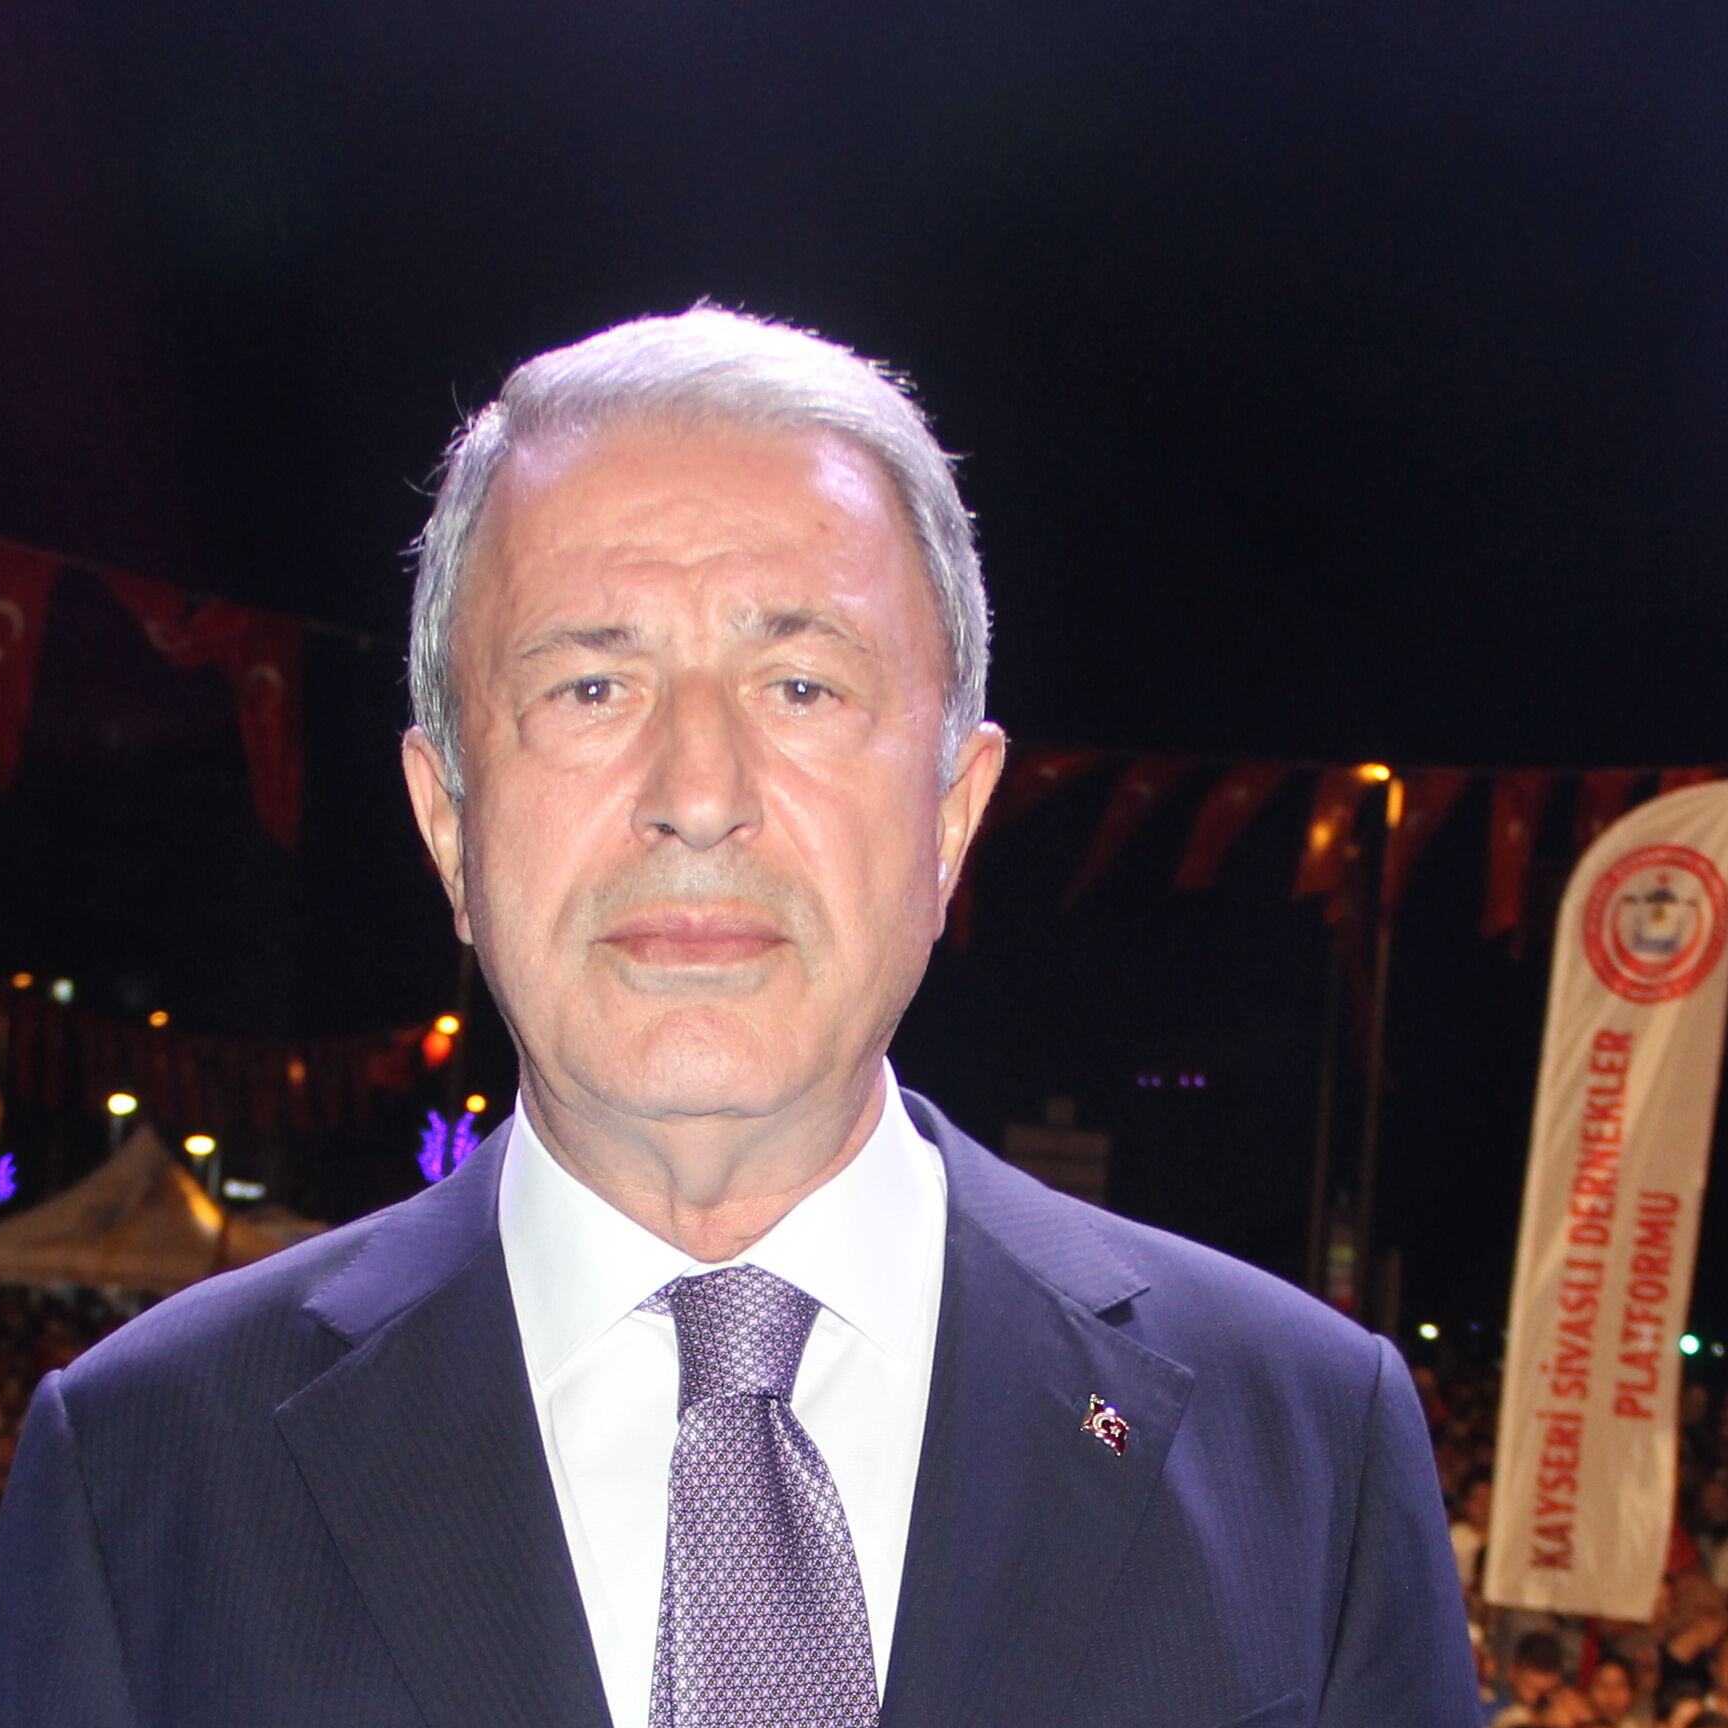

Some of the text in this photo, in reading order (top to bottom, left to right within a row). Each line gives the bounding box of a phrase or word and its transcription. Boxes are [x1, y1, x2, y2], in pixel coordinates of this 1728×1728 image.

[1529, 1029, 1634, 1571] KAYSERİ SİVASLI DERNEKLER
[1613, 1191, 1680, 1420] PLATFORMU
